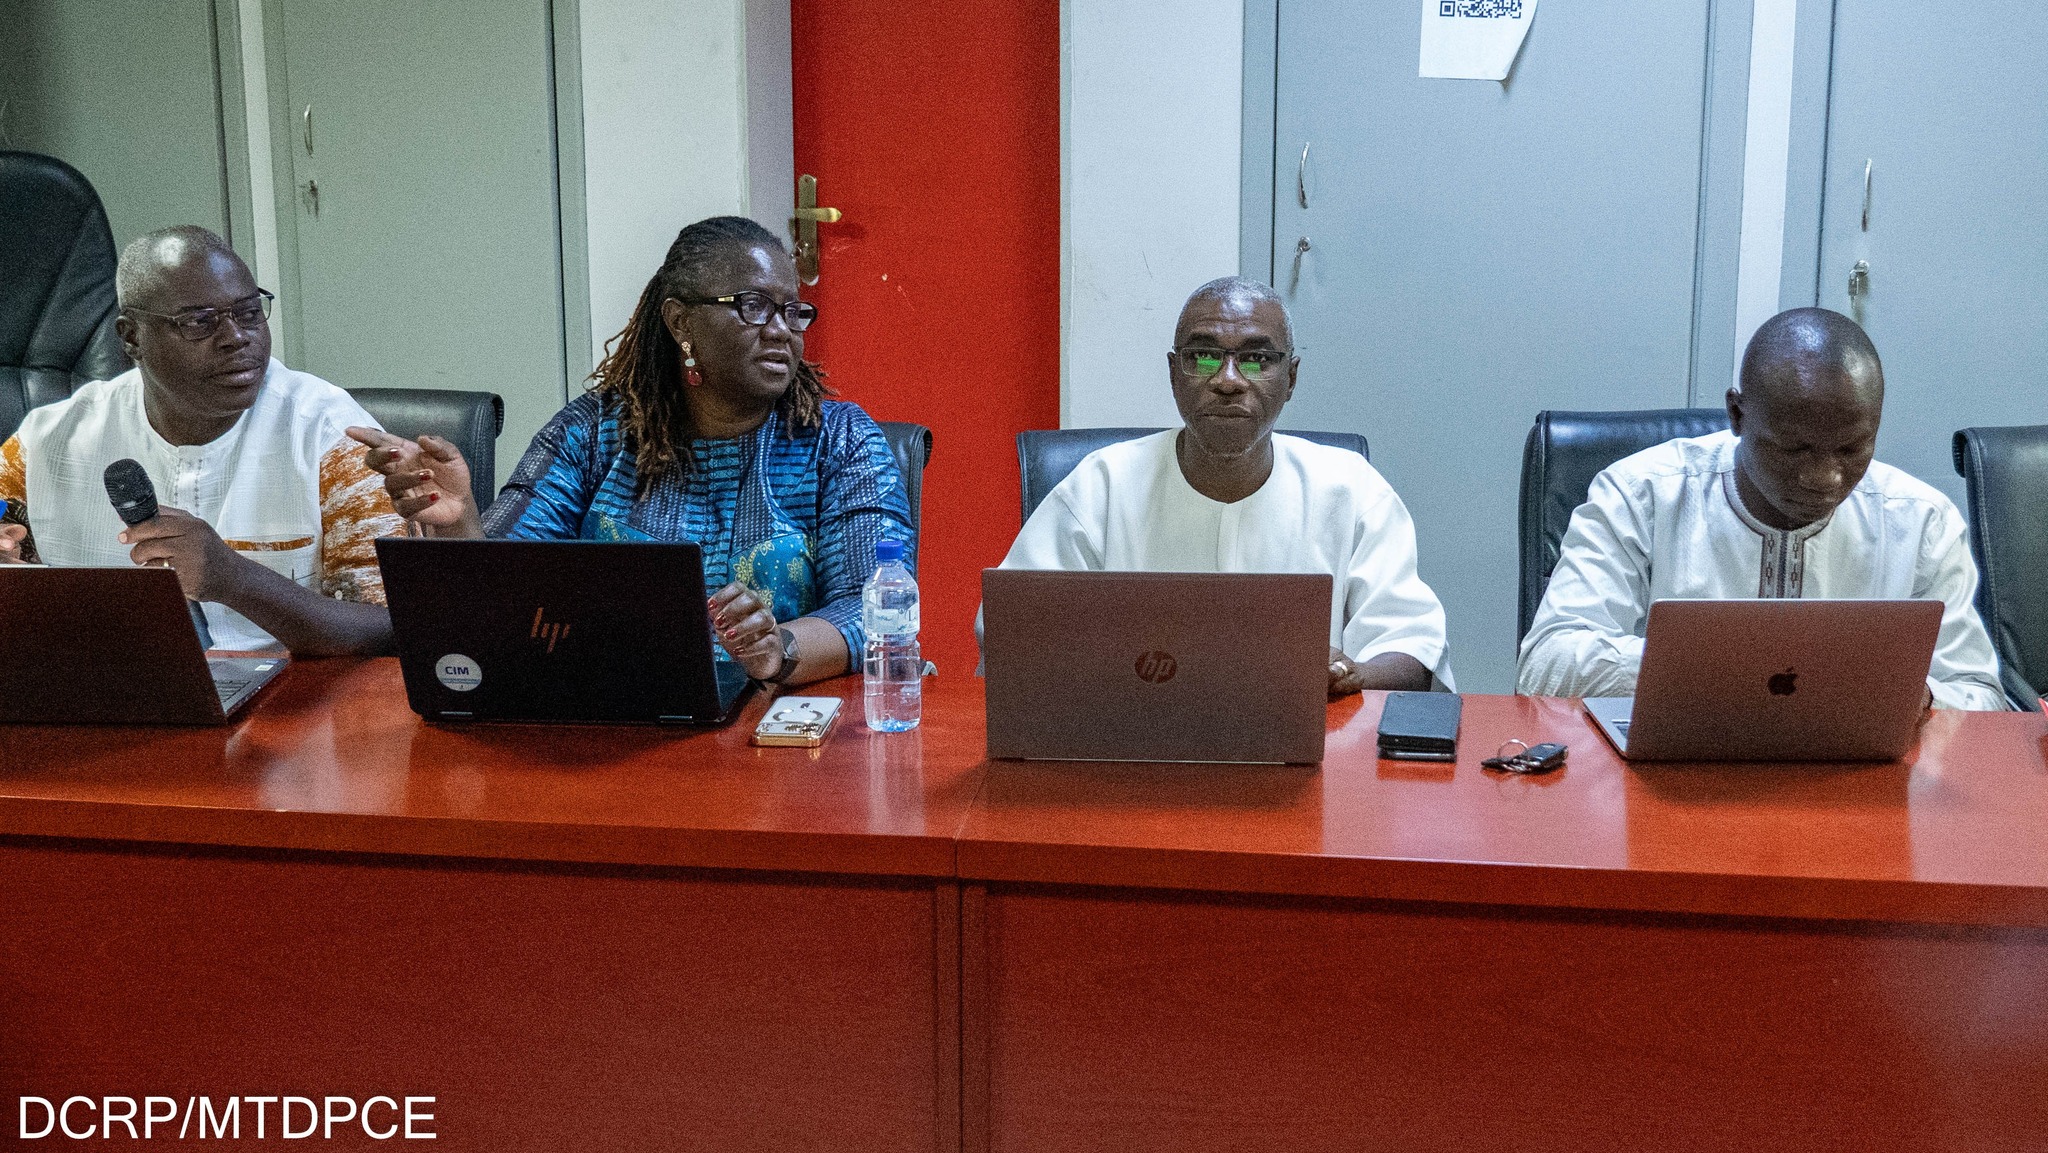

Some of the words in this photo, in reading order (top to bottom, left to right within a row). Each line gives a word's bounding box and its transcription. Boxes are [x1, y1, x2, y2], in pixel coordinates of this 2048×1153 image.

[530, 607, 571, 654] hp
[444, 666, 470, 675] CIM
[1139, 650, 1175, 683] hp
